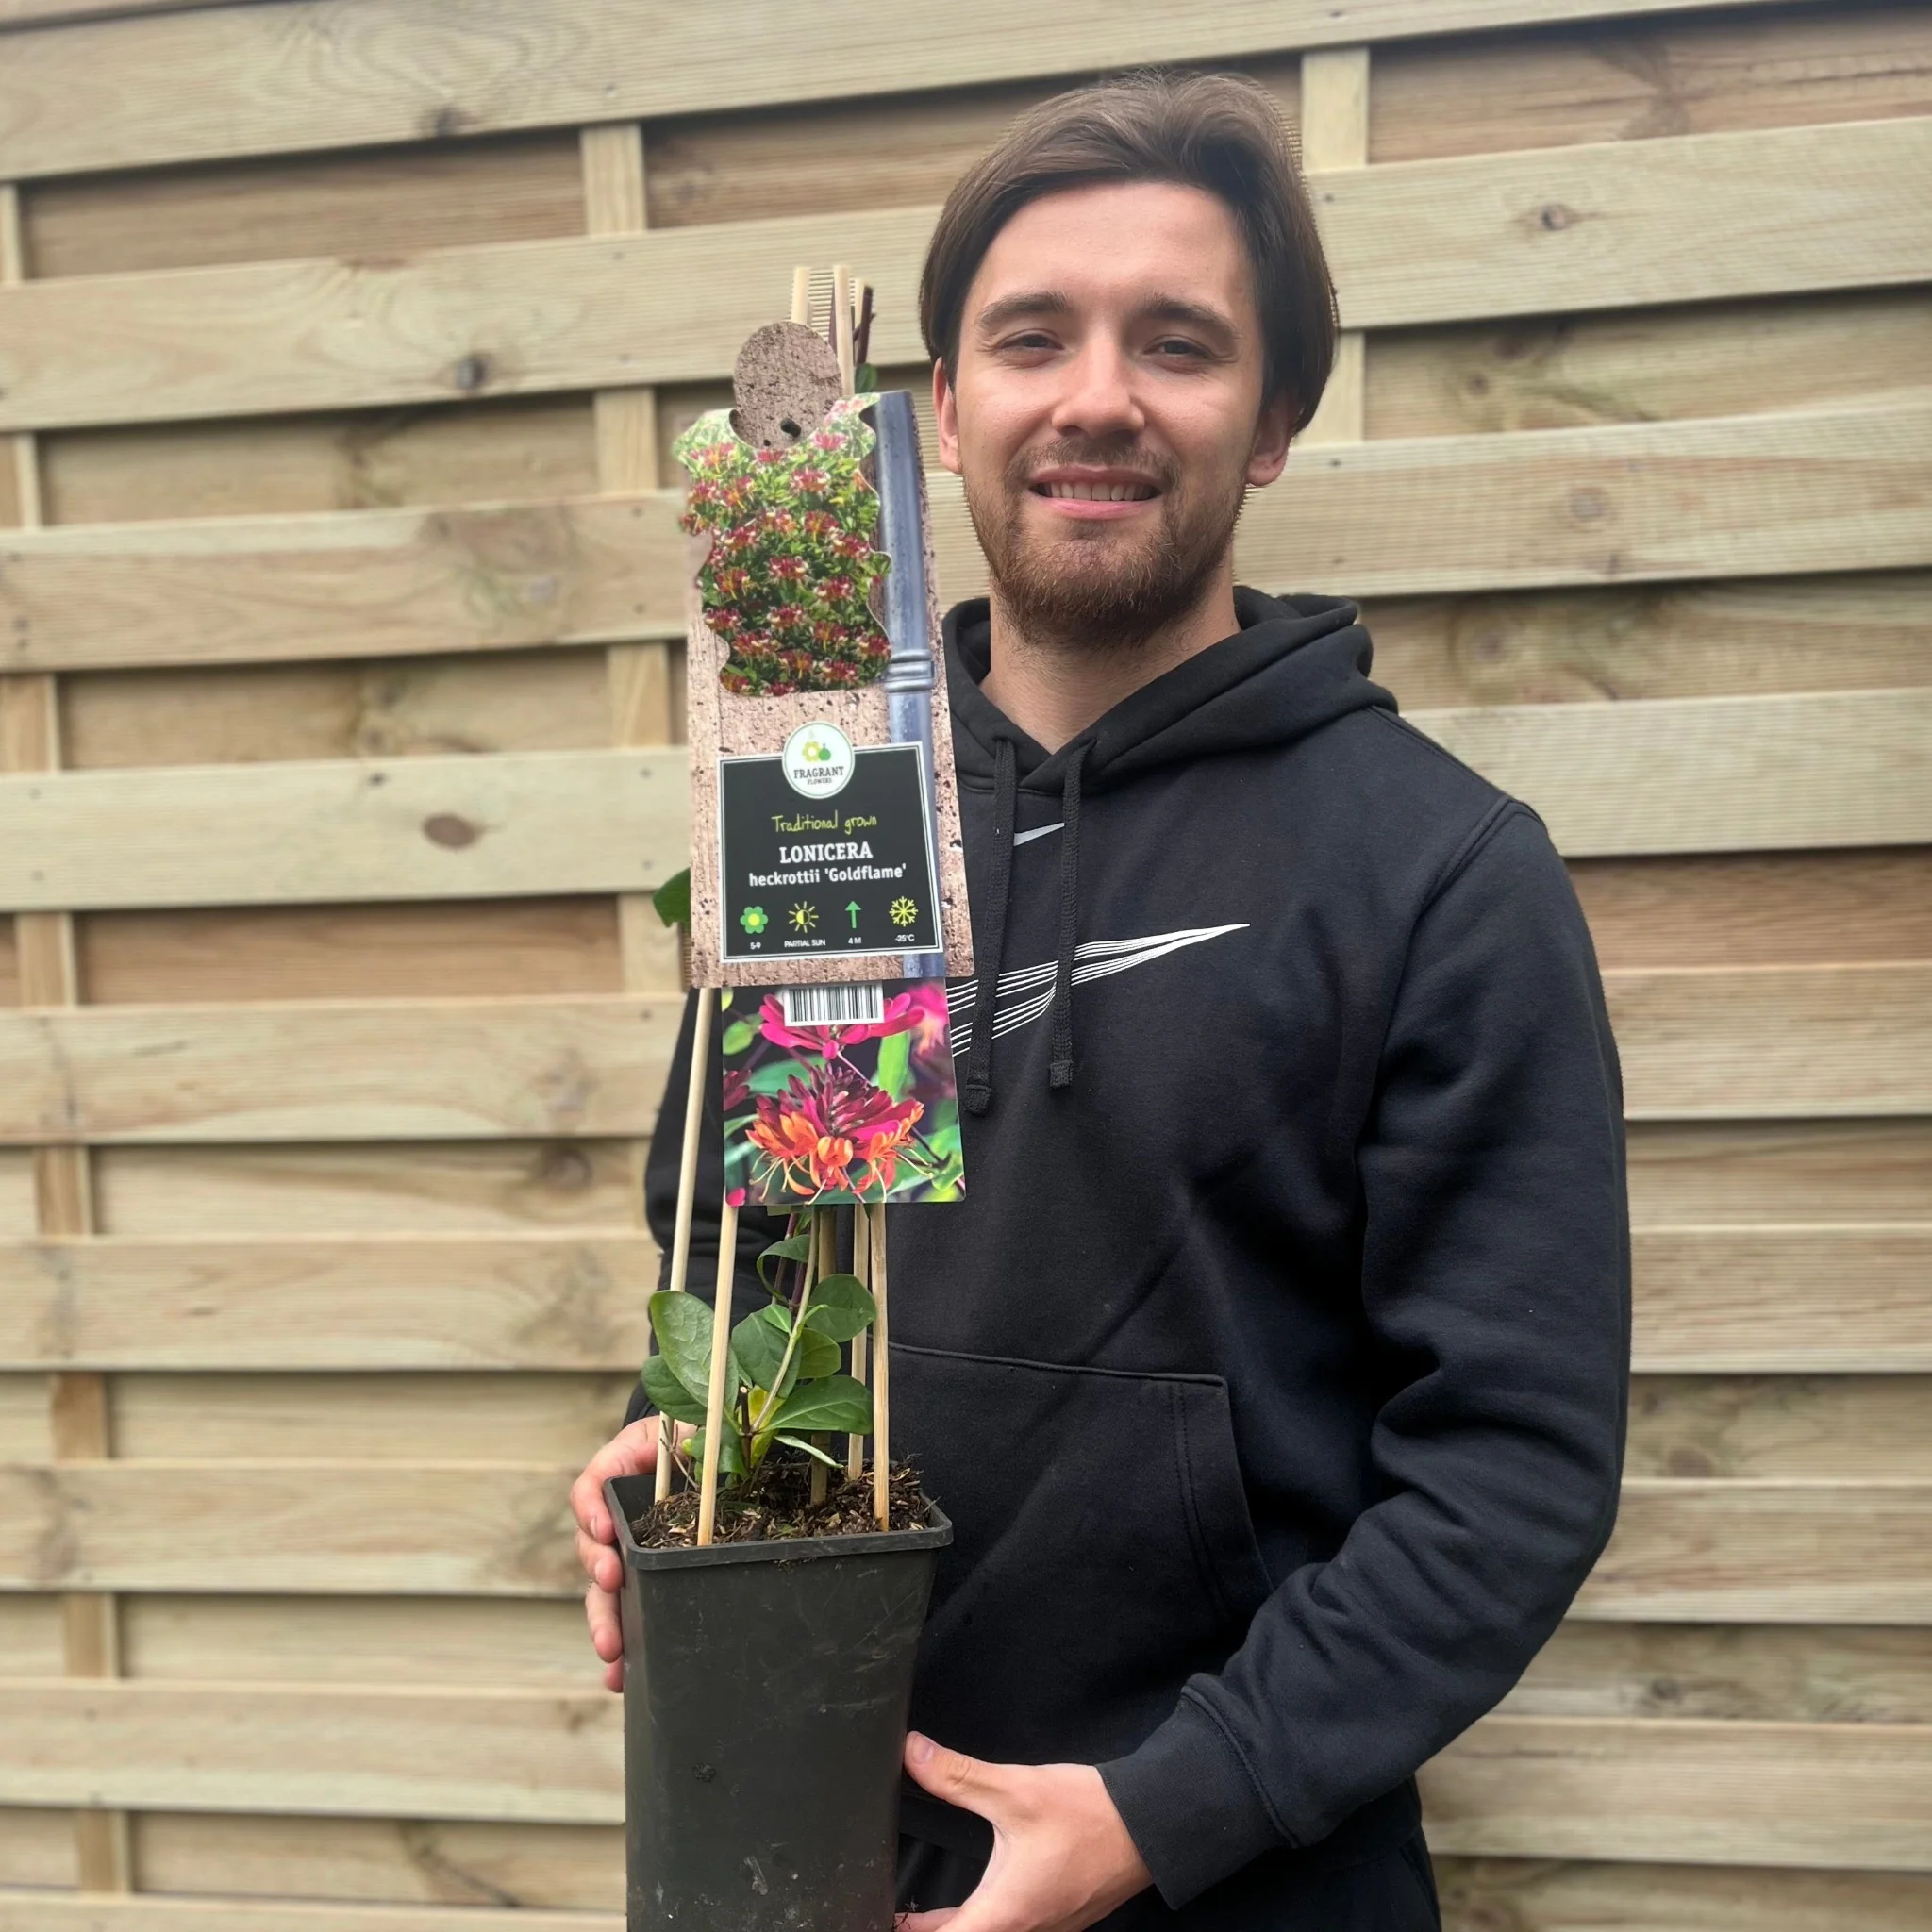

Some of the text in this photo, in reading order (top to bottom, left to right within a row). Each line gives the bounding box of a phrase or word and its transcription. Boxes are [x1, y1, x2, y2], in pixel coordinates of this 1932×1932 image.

[793, 766, 844, 779] FRAGRANT
[771, 809, 877, 835] Traditional grown
[779, 841, 874, 863] LONICERA
[749, 863, 907, 887] heckrottii 'Goldflame'
[784, 939, 826, 948] PARTIAL SUN
